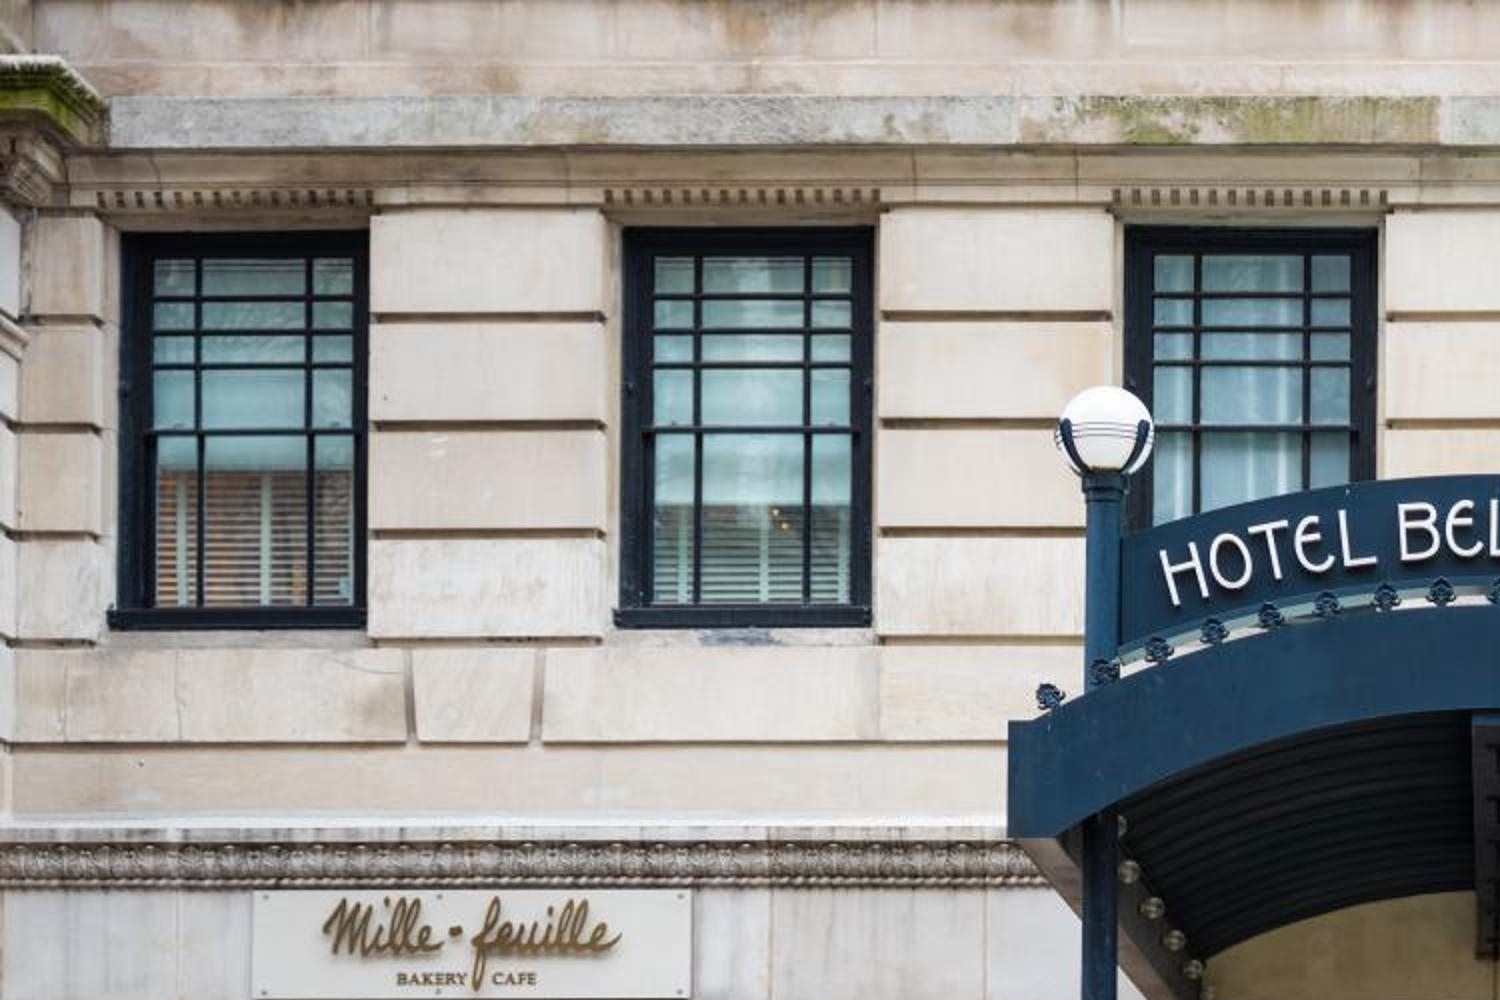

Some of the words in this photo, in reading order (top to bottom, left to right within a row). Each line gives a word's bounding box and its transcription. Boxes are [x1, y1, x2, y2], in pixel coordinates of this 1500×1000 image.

[1159, 508, 1379, 607] HOTEL
[396, 972, 469, 987] BAKERY
[492, 972, 537, 987] CAFE
